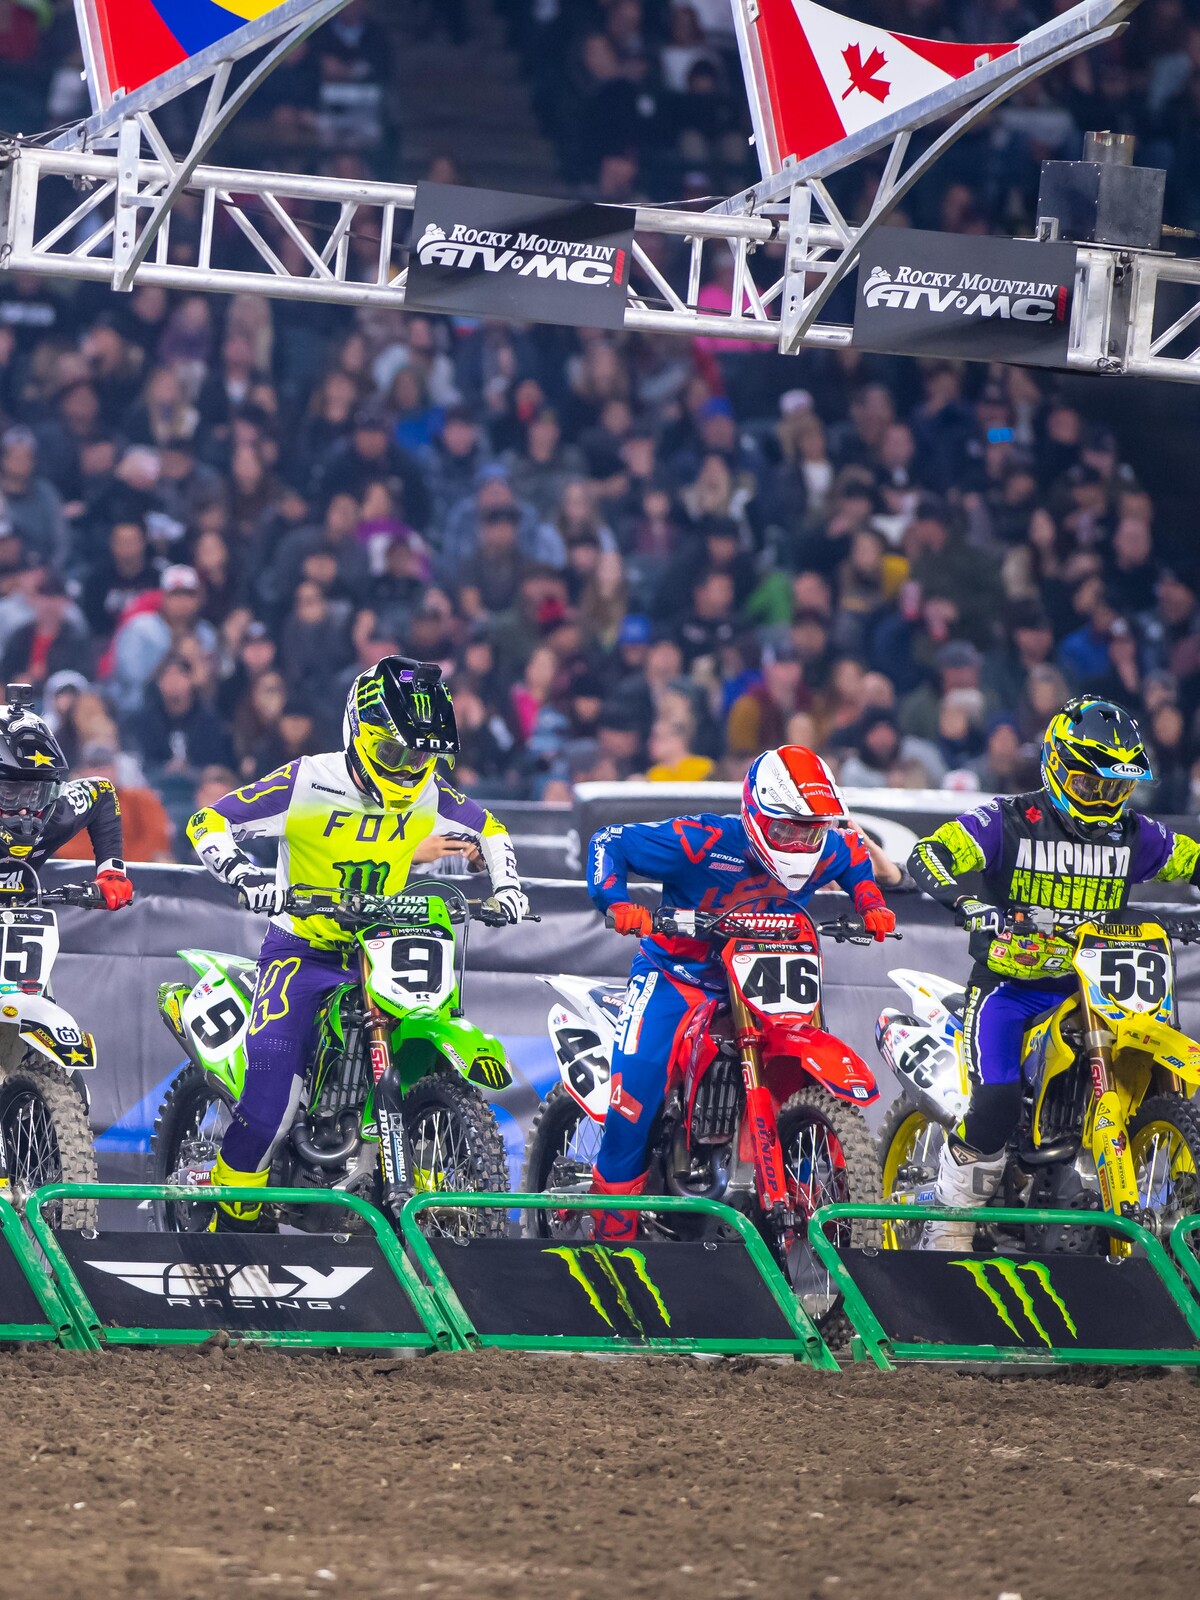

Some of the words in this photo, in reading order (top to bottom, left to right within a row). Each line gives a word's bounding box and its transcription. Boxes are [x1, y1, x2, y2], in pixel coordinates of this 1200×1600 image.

[448, 224, 514, 248] ROCKY
[512, 233, 616, 261] MOUNTAIN
[894, 266, 956, 288] ROCKY
[957, 272, 1058, 298] MOUNTAIN
[416, 738, 455, 749] FOX
[1112, 764, 1141, 774] Arai
[311, 782, 346, 796] Kawasaki
[323, 810, 413, 842] FOX
[709, 852, 745, 864] DUNLOP
[1015, 837, 1131, 877] ANSWER
[363, 903, 428, 914] RNTHA
[1052, 910, 1106, 925] UZUKI
[399, 927, 432, 935] MONSTER
[1096, 923, 1141, 937] PROTAPER
[765, 943, 799, 951] MONSTER
[391, 938, 444, 994] 9
[741, 956, 818, 1005] 46
[1100, 950, 1167, 1004] 53
[191, 997, 246, 1050] 9
[555, 1028, 610, 1098] 46
[900, 1034, 956, 1089] 53
[379, 1108, 394, 1184] DUNLOP
[756, 1117, 778, 1192] DUNLOP
[917, 1190, 935, 1202] JGR
[125, 1261, 375, 1298] FLY
[166, 1298, 333, 1311] RACING
